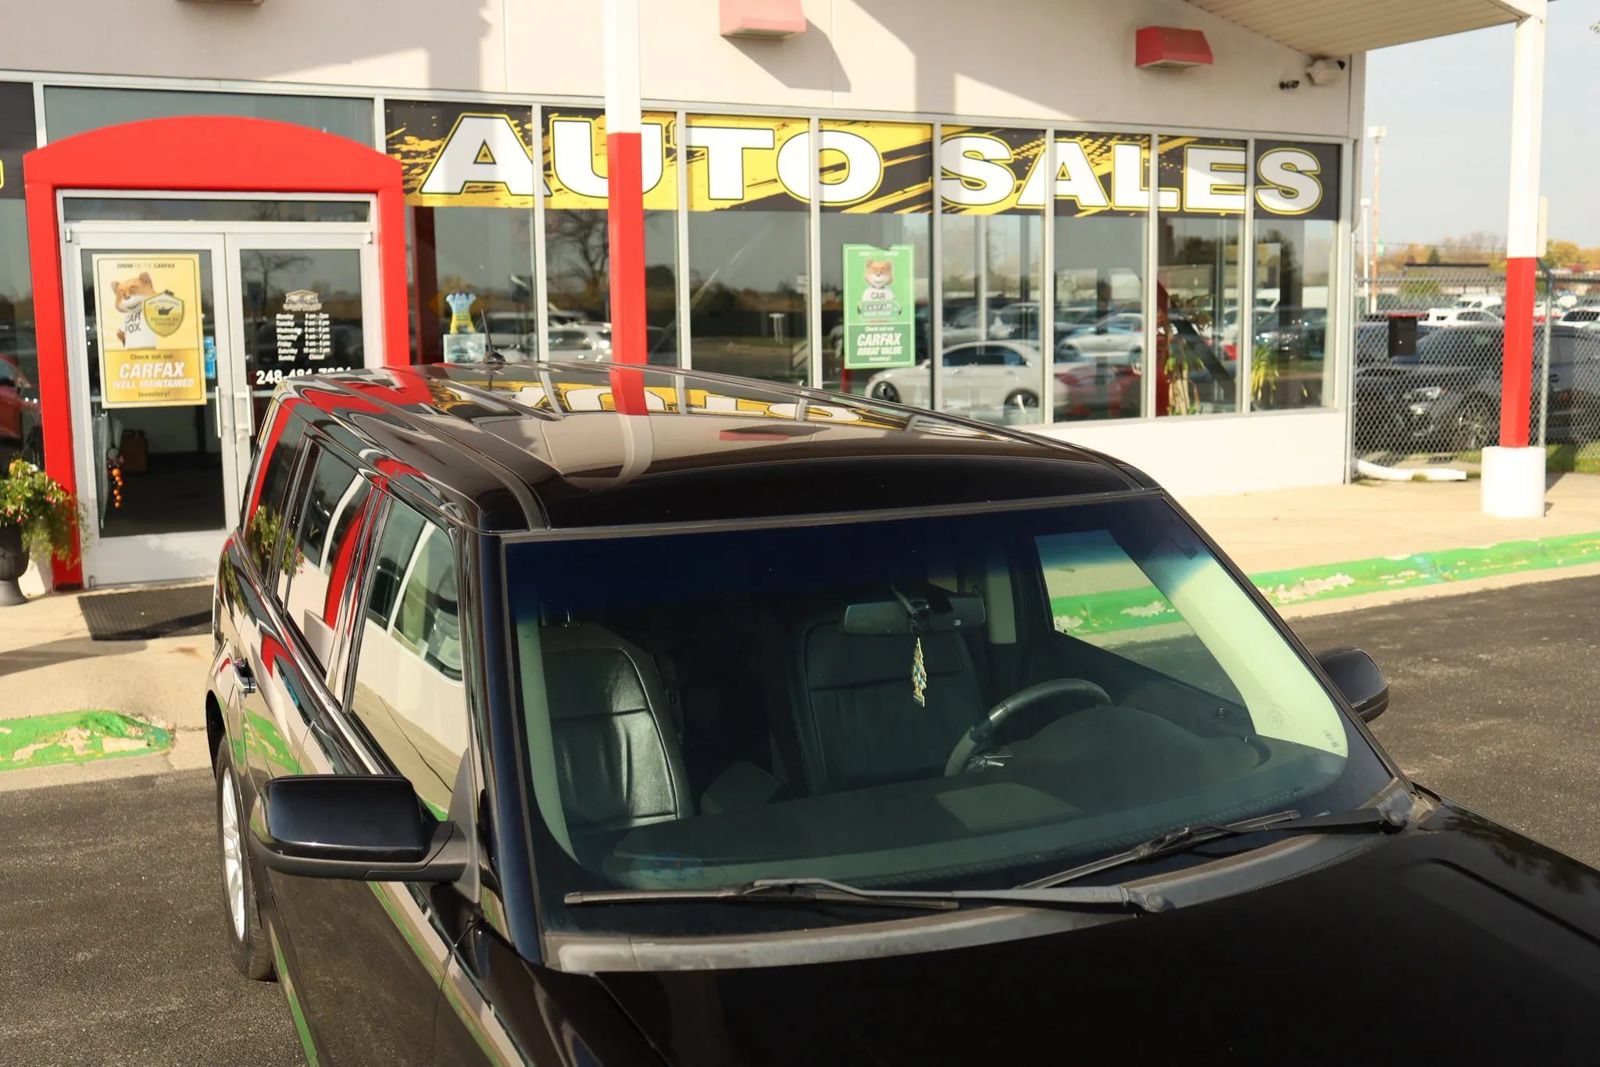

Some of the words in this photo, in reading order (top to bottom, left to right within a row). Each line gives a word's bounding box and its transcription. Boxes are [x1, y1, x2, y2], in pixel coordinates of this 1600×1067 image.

[419, 113, 884, 205] AUTO
[939, 133, 1323, 214] SALES
[857, 333, 902, 347] CARFAX
[857, 346, 880, 356] GREAT
[880, 345, 903, 355] VALUE
[119, 361, 185, 379] CARFAX
[112, 380, 137, 390] WELL
[140, 378, 194, 389] MAINTAINED
